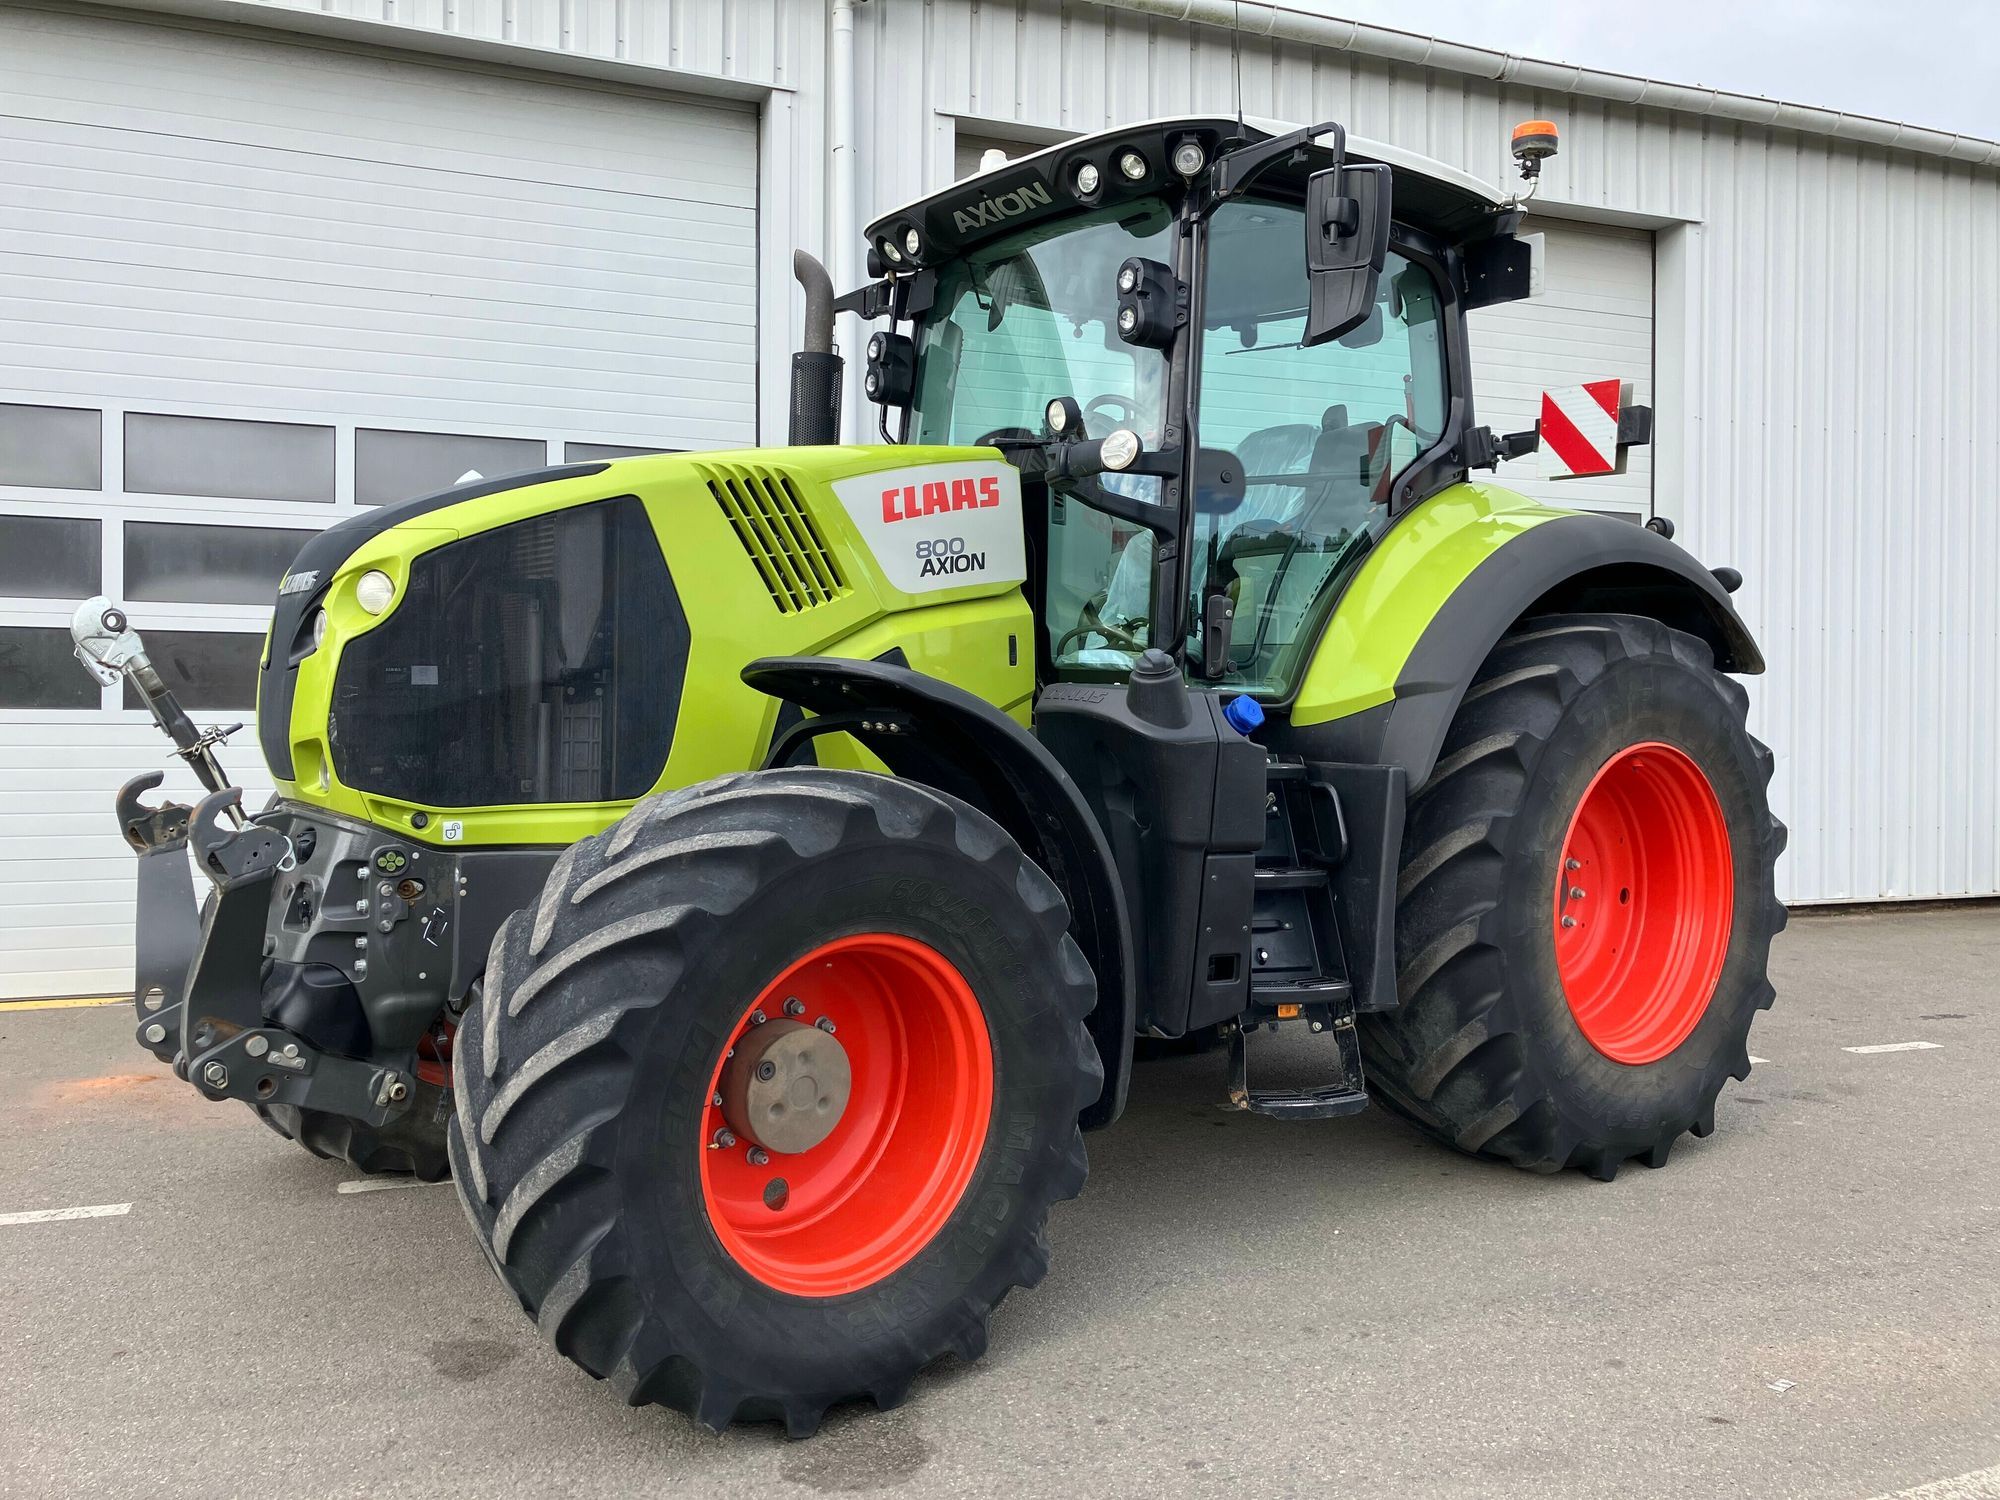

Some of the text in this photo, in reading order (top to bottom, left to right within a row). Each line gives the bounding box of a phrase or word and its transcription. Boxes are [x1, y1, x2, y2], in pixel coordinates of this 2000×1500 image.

[953, 181, 1053, 234] AXION
[881, 476, 1000, 524] CLAAS
[915, 537, 965, 559] 800
[919, 551, 986, 578] AXION
